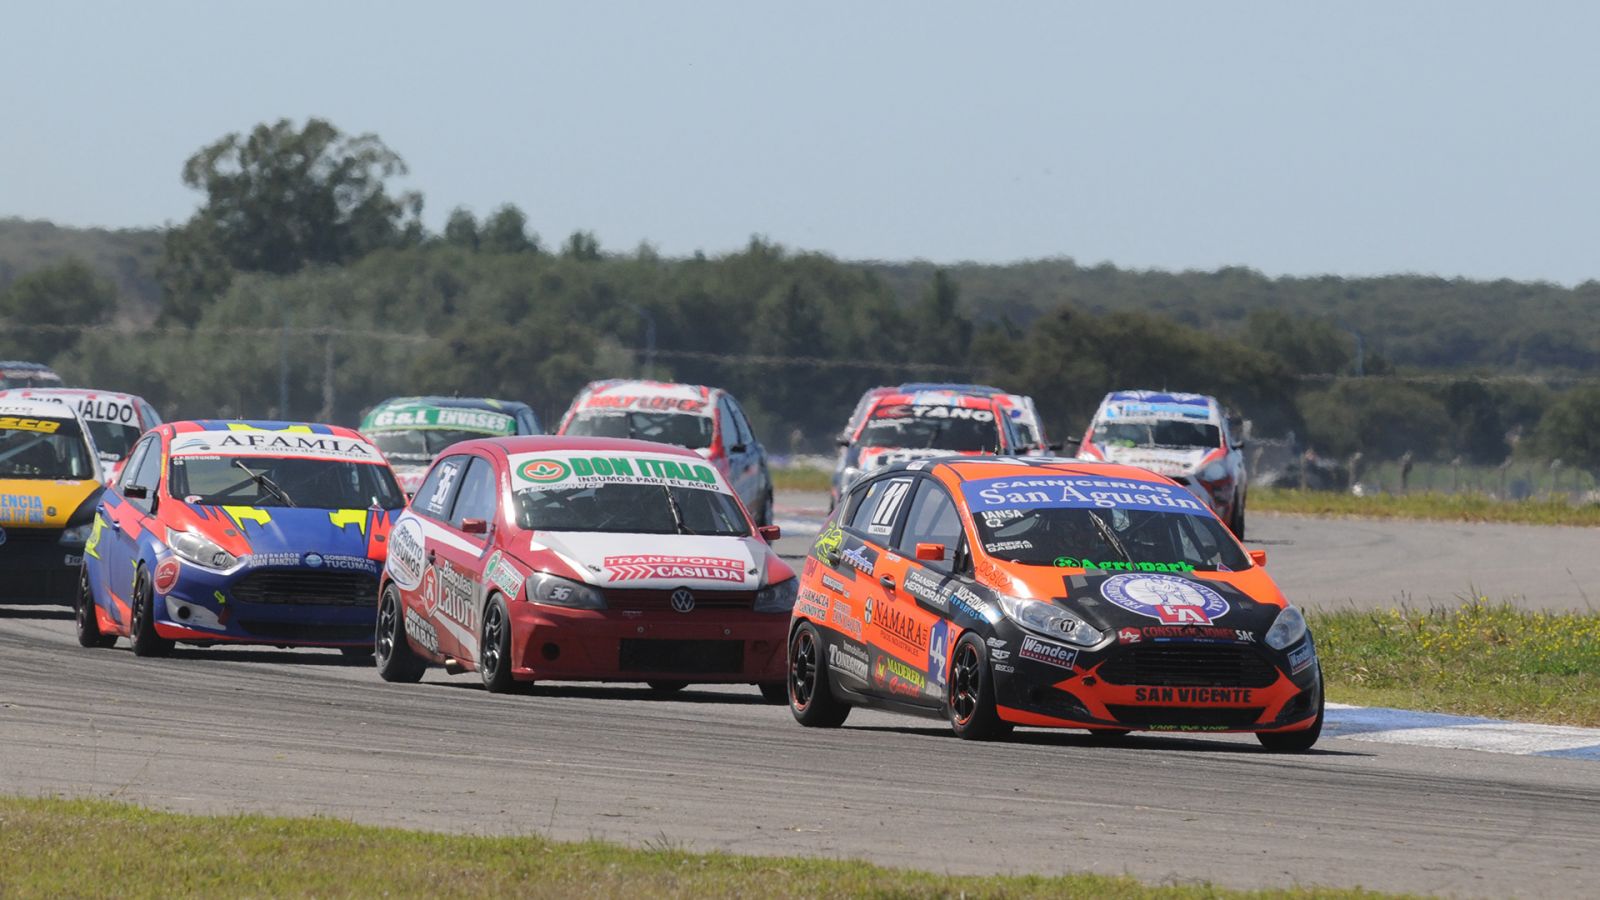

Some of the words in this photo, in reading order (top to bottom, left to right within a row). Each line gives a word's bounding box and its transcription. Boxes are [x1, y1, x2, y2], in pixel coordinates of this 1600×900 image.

[437, 410, 507, 431] ENVASES
[219, 434, 373, 454] AFAMIA
[568, 457, 635, 477] DON
[635, 458, 717, 485] ITALO
[577, 476, 633, 484] INSUMOS
[636, 477, 666, 485] PARA
[669, 479, 684, 487] EL
[687, 481, 720, 491] AGRO
[991, 480, 1173, 494] CARNICERIAS
[872, 483, 911, 525] 11
[979, 487, 1051, 506] San
[1059, 486, 1202, 511] Agustin
[981, 509, 1024, 519] IANSA
[986, 519, 1004, 528] C2
[247, 552, 299, 560] GOBERNADOR
[248, 558, 268, 568] JUAN
[323, 554, 365, 563] GOBIERNO
[608, 556, 742, 568] TRANSPORTE
[657, 566, 742, 580] CASILDA
[910, 572, 952, 596] TRANSPOTE
[550, 587, 572, 600] 36
[874, 599, 922, 646] NAMARA
[1061, 620, 1073, 632] 11
[1024, 638, 1074, 661] Wander
[887, 656, 925, 689] MADERERA
[1135, 687, 1173, 702] SAN
[1178, 688, 1252, 703] VICENTE
